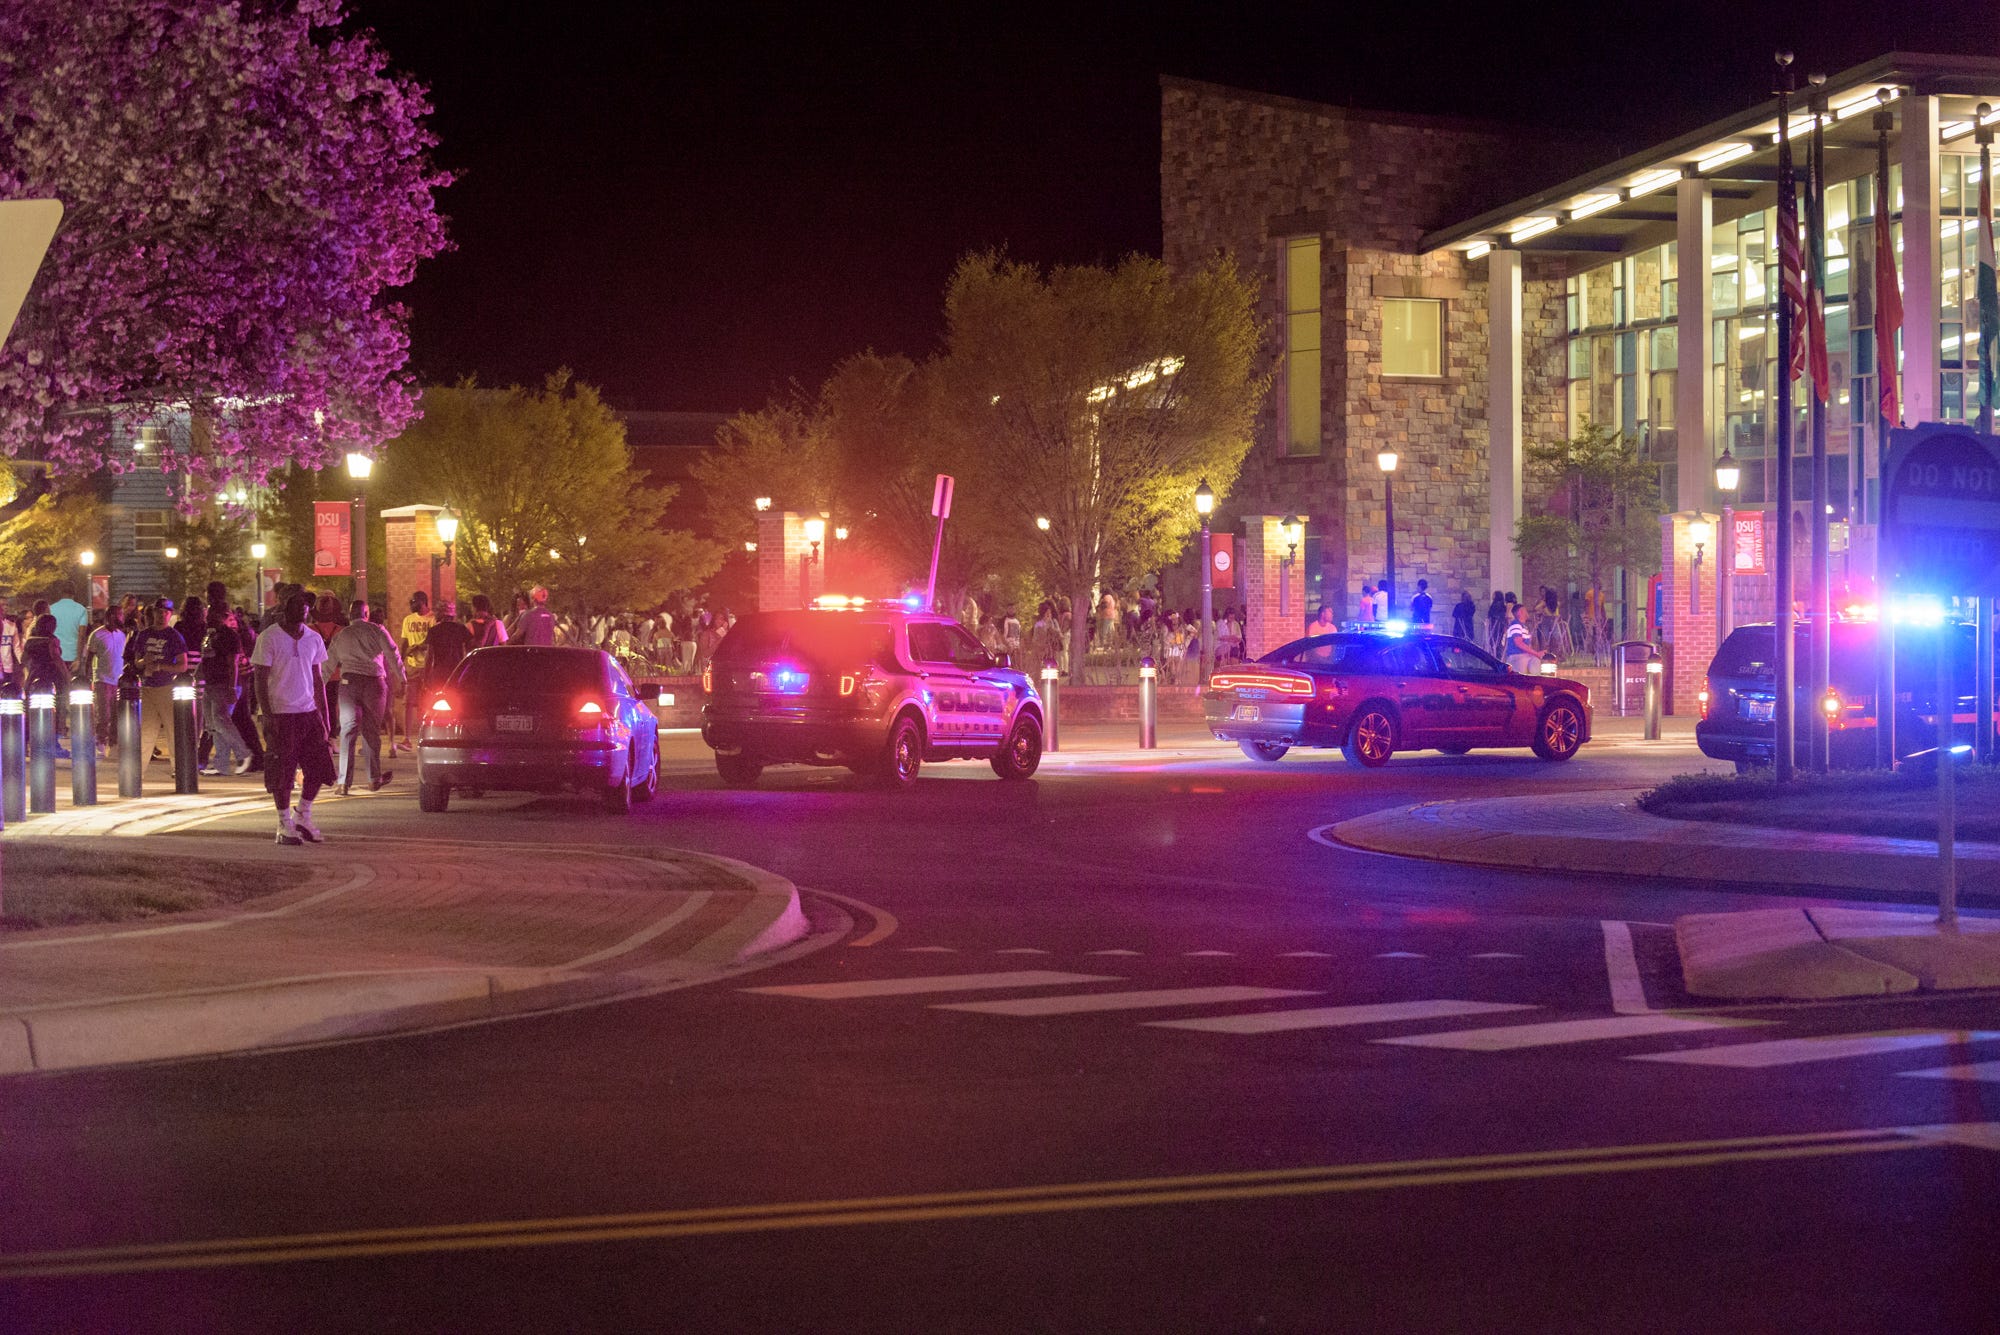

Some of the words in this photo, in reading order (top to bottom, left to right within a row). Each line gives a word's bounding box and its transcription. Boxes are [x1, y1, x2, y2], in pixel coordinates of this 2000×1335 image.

[1909, 463, 1939, 487] DO
[1952, 466, 1995, 493] NOT
[317, 512, 339, 527] DSU
[1735, 520, 1754, 533] DSU
[340, 534, 349, 566] VALUES
[1755, 538, 1764, 567] VALUES
[937, 691, 1003, 713] OLICE
[936, 722, 1000, 732] MILFORD
